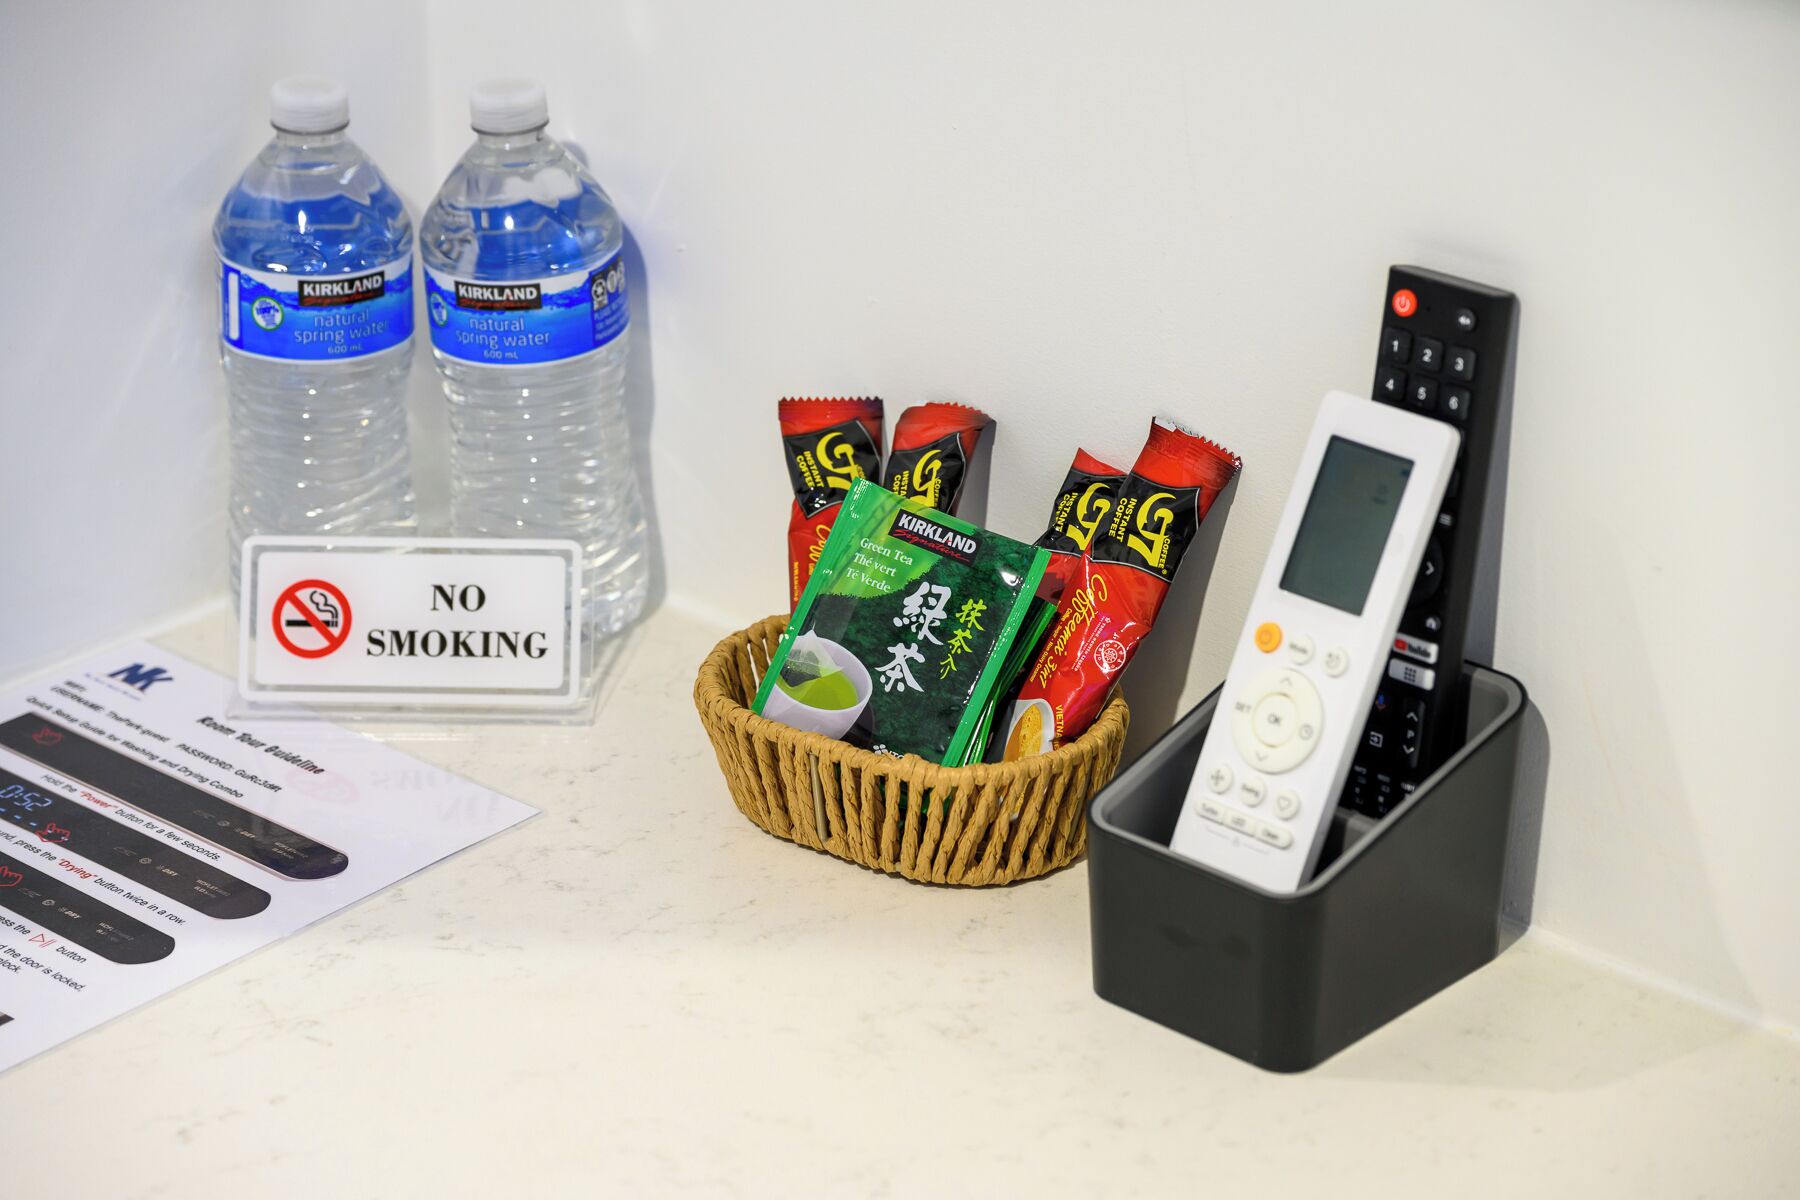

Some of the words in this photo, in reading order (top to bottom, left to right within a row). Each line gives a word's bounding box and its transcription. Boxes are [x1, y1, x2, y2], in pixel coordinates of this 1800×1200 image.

[303, 275, 383, 296] KIRKLAND
[458, 284, 538, 300] KIRKLAND
[294, 329, 344, 345] spring
[350, 320, 388, 339] water
[314, 309, 369, 327] natural
[469, 318, 525, 332] natural
[328, 345, 347, 354] 600
[456, 331, 498, 349] spring
[503, 332, 550, 347] water
[484, 350, 502, 359] 600
[1392, 339, 1399, 352] 1
[1422, 348, 1432, 362] 2
[1454, 357, 1464, 371] 3
[1385, 378, 1394, 391] 4
[1417, 386, 1427, 400] 5
[1449, 396, 1459, 410] 6
[795, 454, 815, 490] COFFEE
[803, 450, 825, 489] INSTANT
[1055, 492, 1078, 533] INSTANT
[1066, 482, 1112, 551] G7
[1108, 498, 1129, 538] COFFEE
[1117, 498, 1138, 543] INSTANT
[892, 528, 970, 563] Signature
[899, 513, 977, 555] KIRKLAND
[1127, 492, 1177, 568] G7
[853, 552, 873, 568] Thé
[872, 562, 897, 578] vert
[860, 537, 892, 558] Green
[893, 549, 914, 566] Tea
[1157, 537, 1171, 569] COFFEE
[846, 567, 861, 581] Té
[860, 573, 891, 593] Verde
[430, 583, 487, 612] NO
[366, 629, 549, 659] SMOKING
[1040, 655, 1058, 689] 3in1
[264, 745, 325, 774] Guideline
[158, 759, 181, 769] and
[177, 766, 209, 784] Drying
[209, 780, 244, 798] Combo
[41, 774, 63, 787] Hold
[62, 783, 78, 793] the
[115, 808, 145, 825] button
[143, 821, 158, 831] for
[164, 831, 183, 842] few
[180, 838, 221, 862] seconds.
[13, 839, 42, 854] press
[40, 851, 57, 862] the
[94, 877, 125, 894] button
[123, 891, 149, 906] twice
[147, 903, 159, 912] in
[165, 912, 187, 926] row.
[14, 924, 31, 935] the
[56, 946, 87, 963] button
[4, 947, 21, 959] the
[20, 956, 44, 969] door
[41, 966, 53, 975] is
